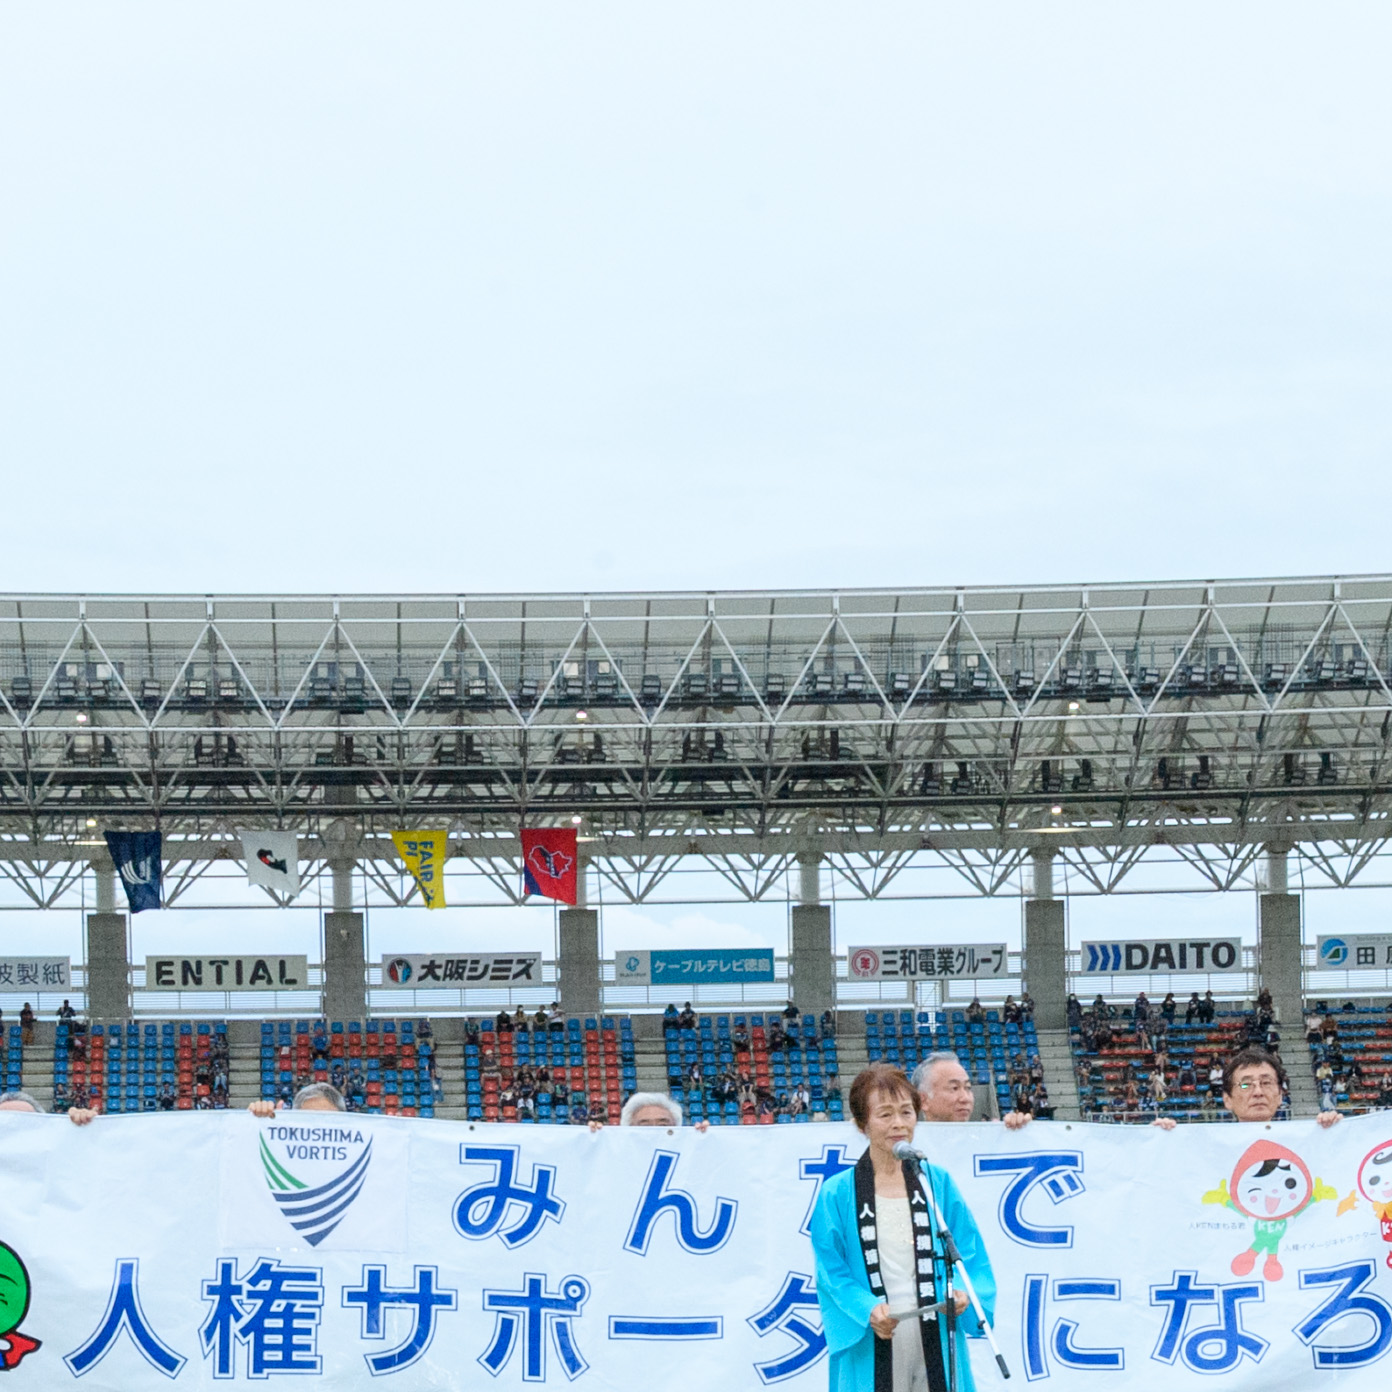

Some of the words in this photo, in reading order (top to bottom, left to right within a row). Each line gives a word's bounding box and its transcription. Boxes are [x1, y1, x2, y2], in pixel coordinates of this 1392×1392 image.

[419, 840, 434, 883] FAIR
[654, 957, 771, 974] ケーブルテレビ徳島
[881, 946, 1005, 977] 三和電業グループ
[1124, 942, 1237, 971] DAITO
[155, 959, 298, 986] ENTIAL
[417, 958, 538, 982] 大阪シミズ
[267, 1126, 364, 1143] TOKUSHIMA
[286, 1145, 347, 1160] VORTIS
[1257, 1220, 1286, 1233] KEN
